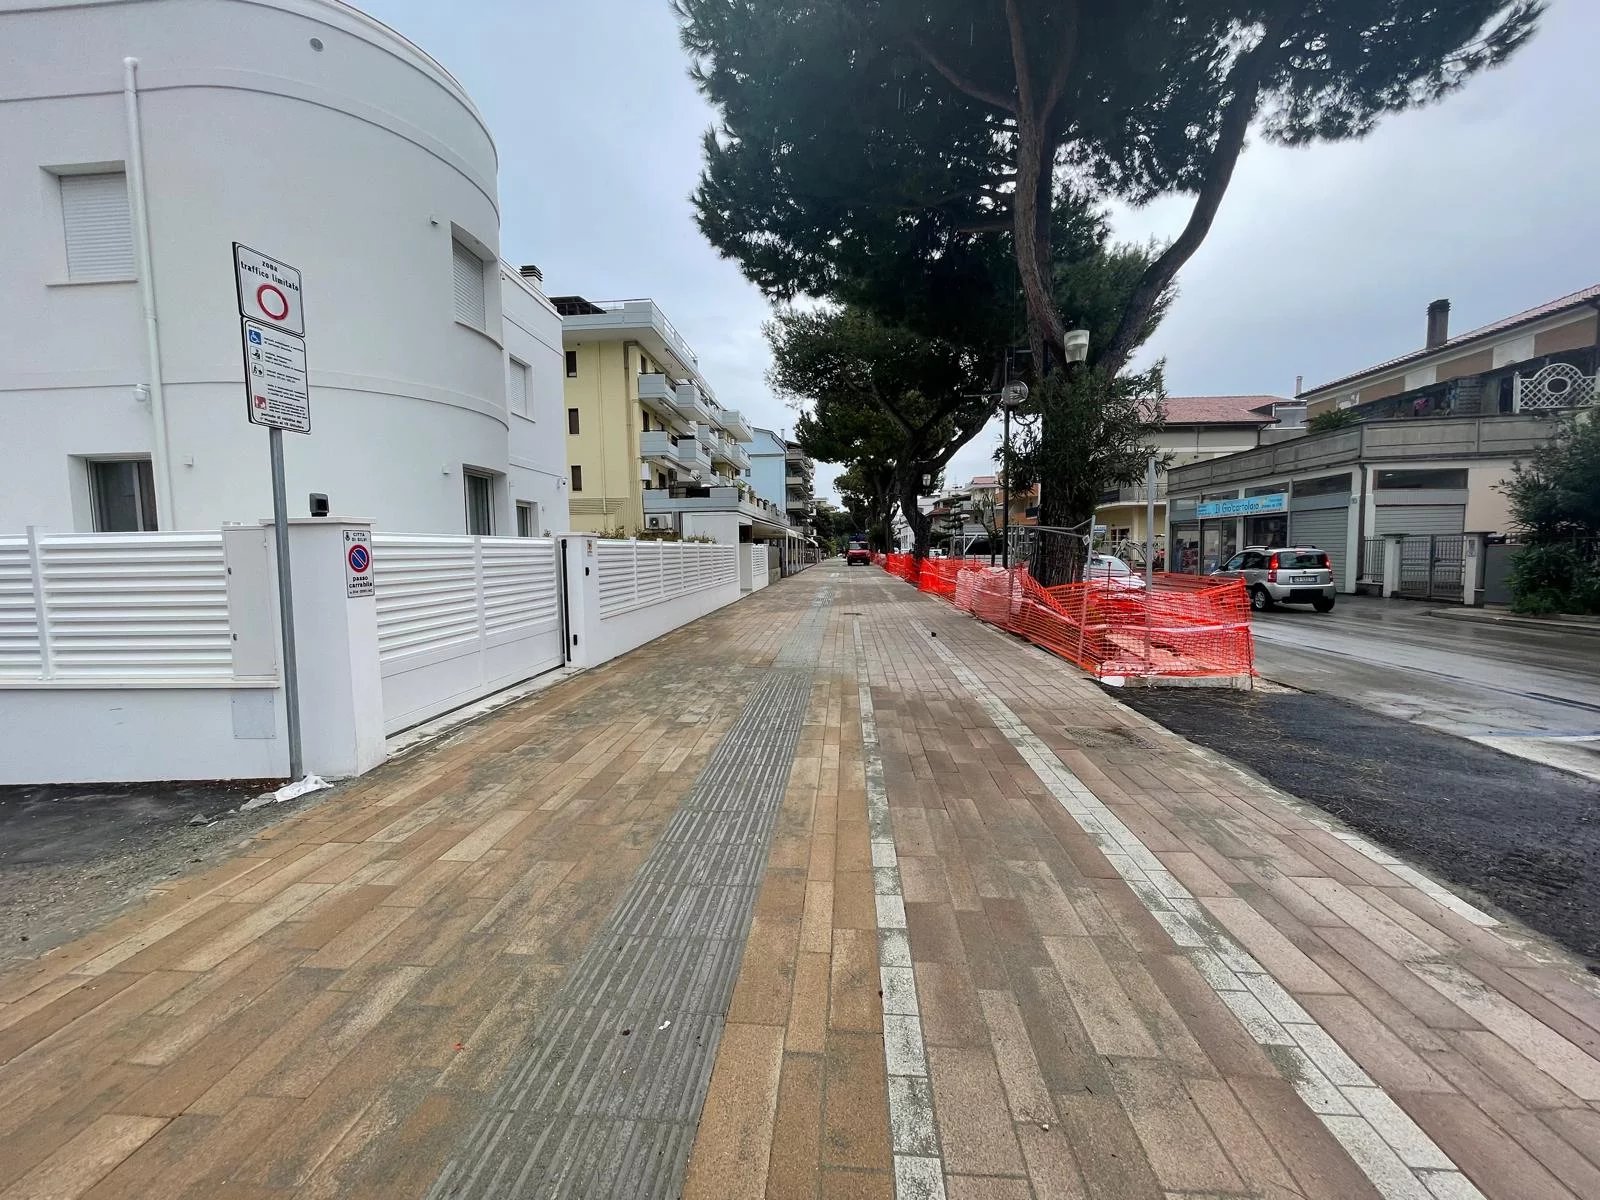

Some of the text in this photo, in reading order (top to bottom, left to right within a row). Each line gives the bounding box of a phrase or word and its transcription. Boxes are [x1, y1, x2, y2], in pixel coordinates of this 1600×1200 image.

[240, 261, 299, 291] traffico limitato
[262, 261, 278, 272] zona
